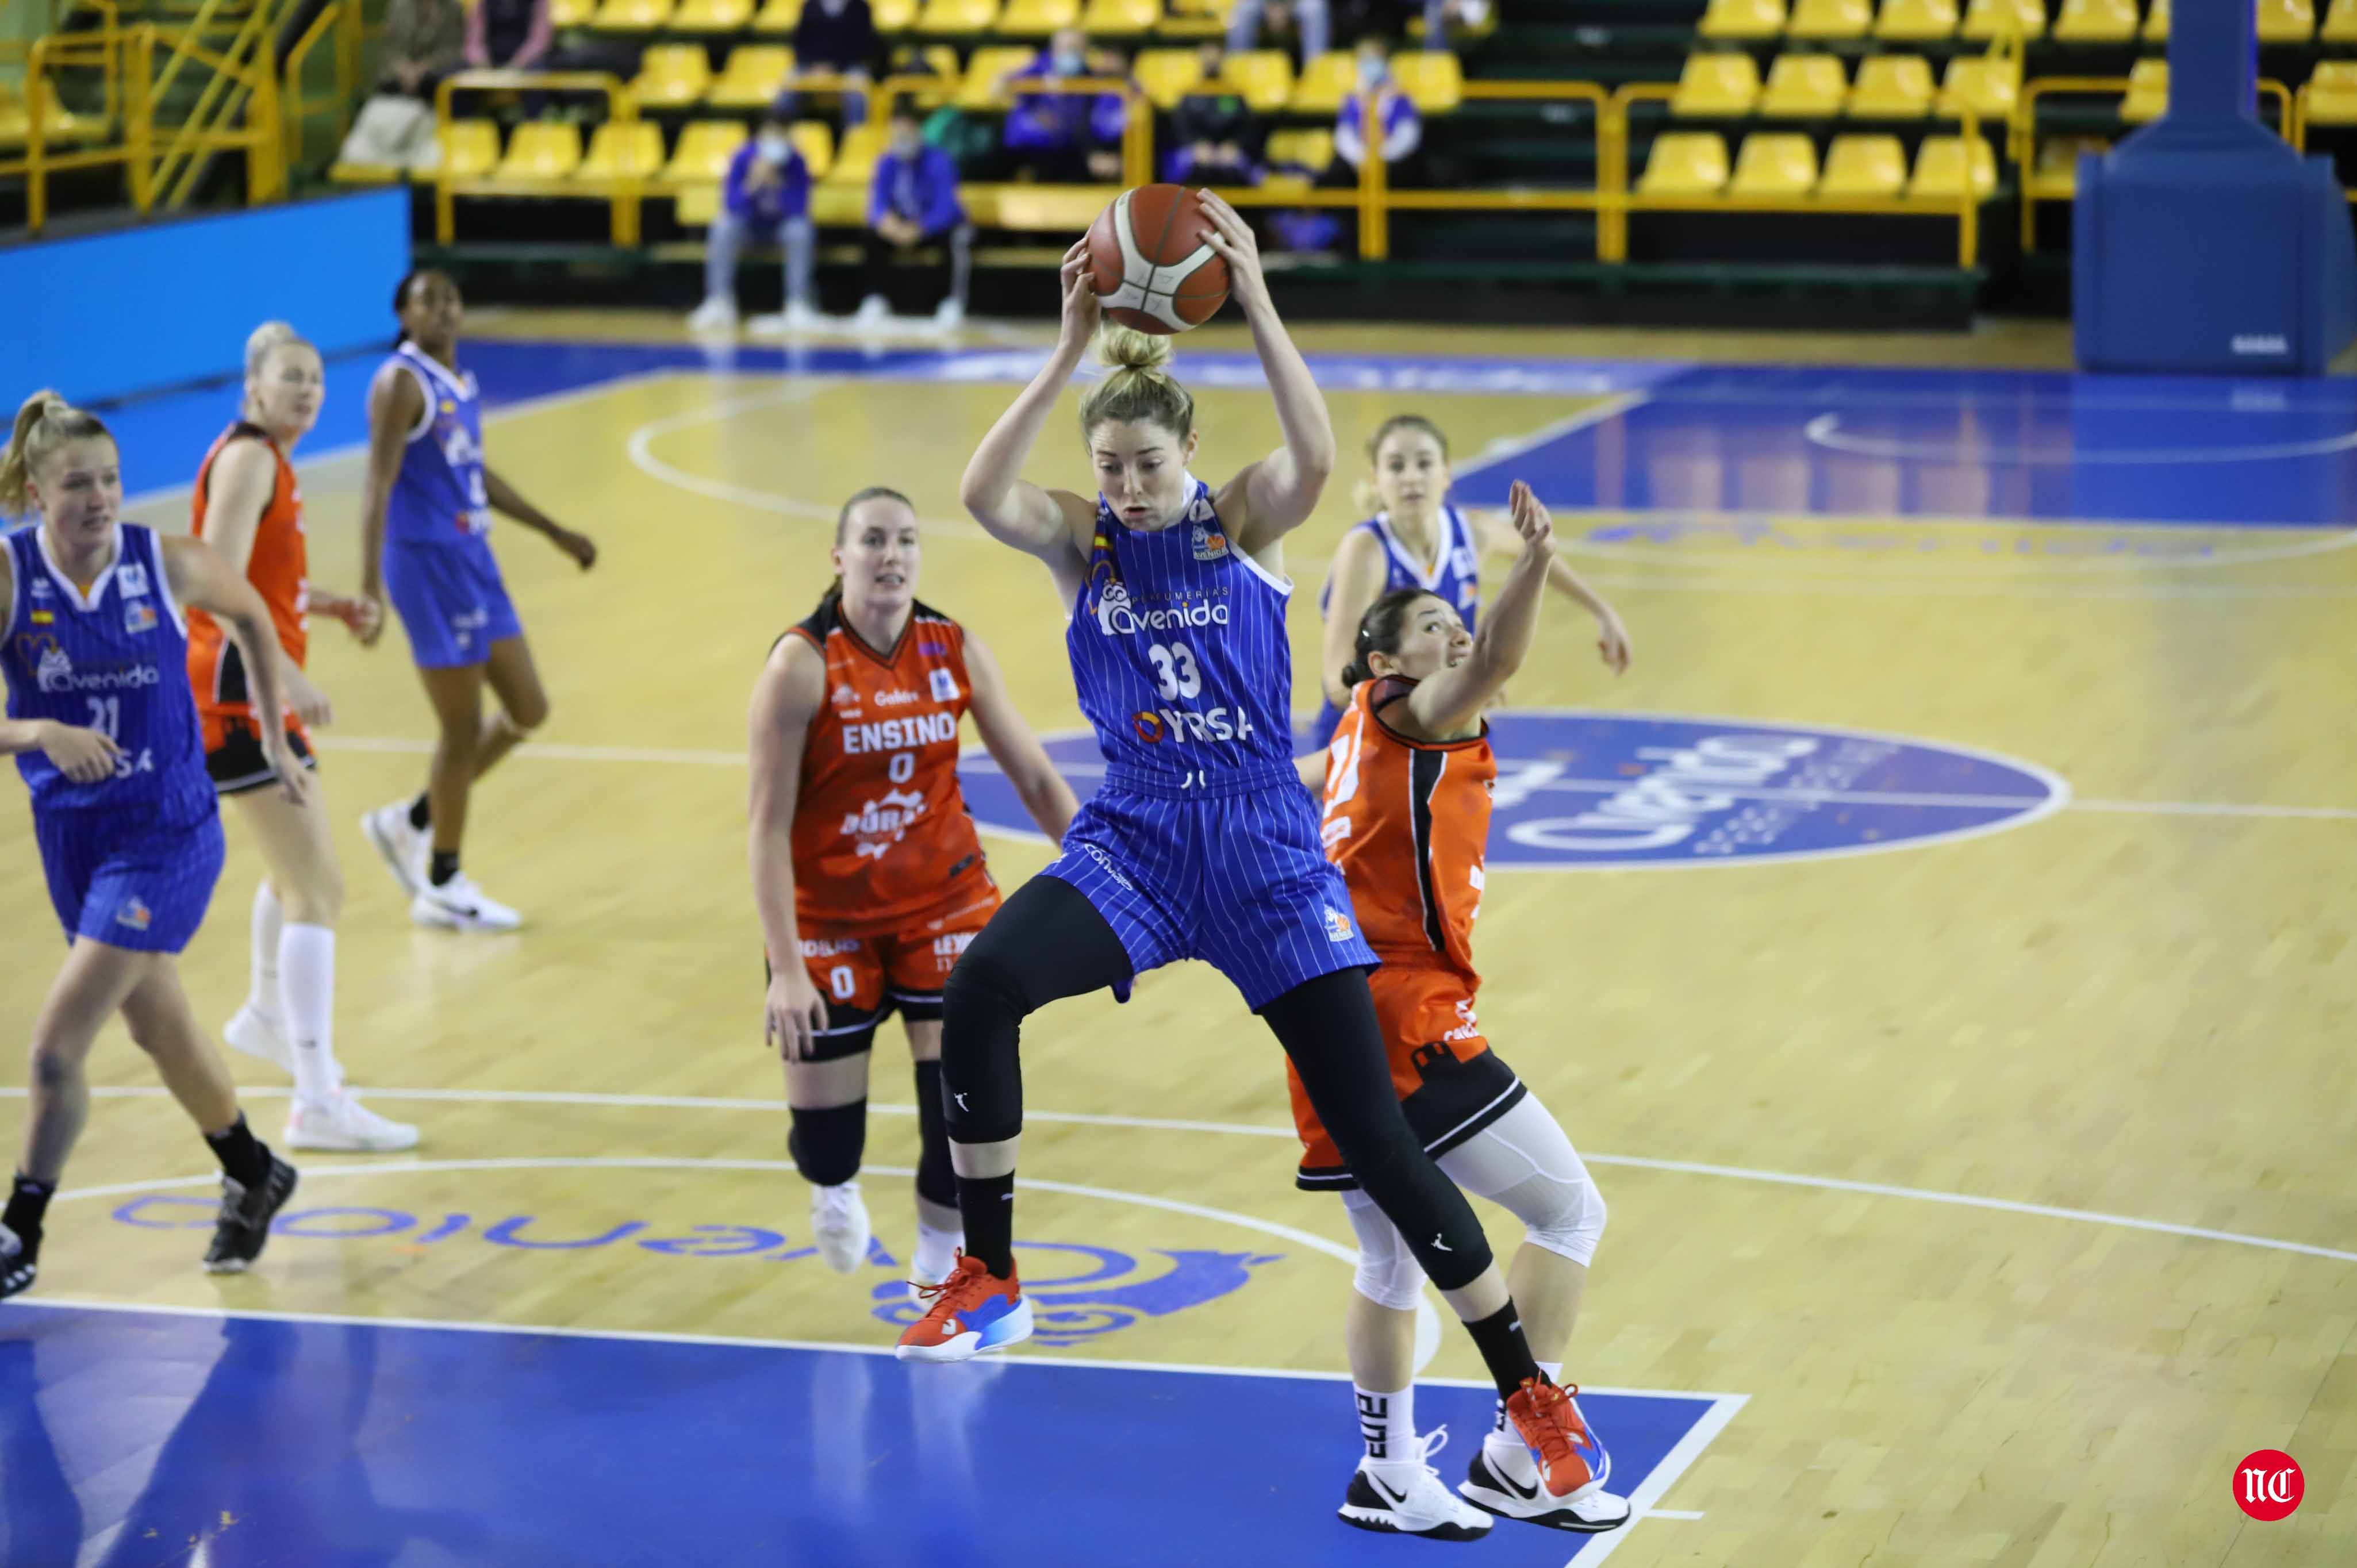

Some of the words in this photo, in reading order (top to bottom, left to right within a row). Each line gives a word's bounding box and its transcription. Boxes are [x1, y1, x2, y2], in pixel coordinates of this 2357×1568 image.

[1148, 641, 1201, 701] 33
[842, 711, 957, 754] ENSINO
[888, 752, 914, 783] 0
[831, 965, 855, 999] 0
